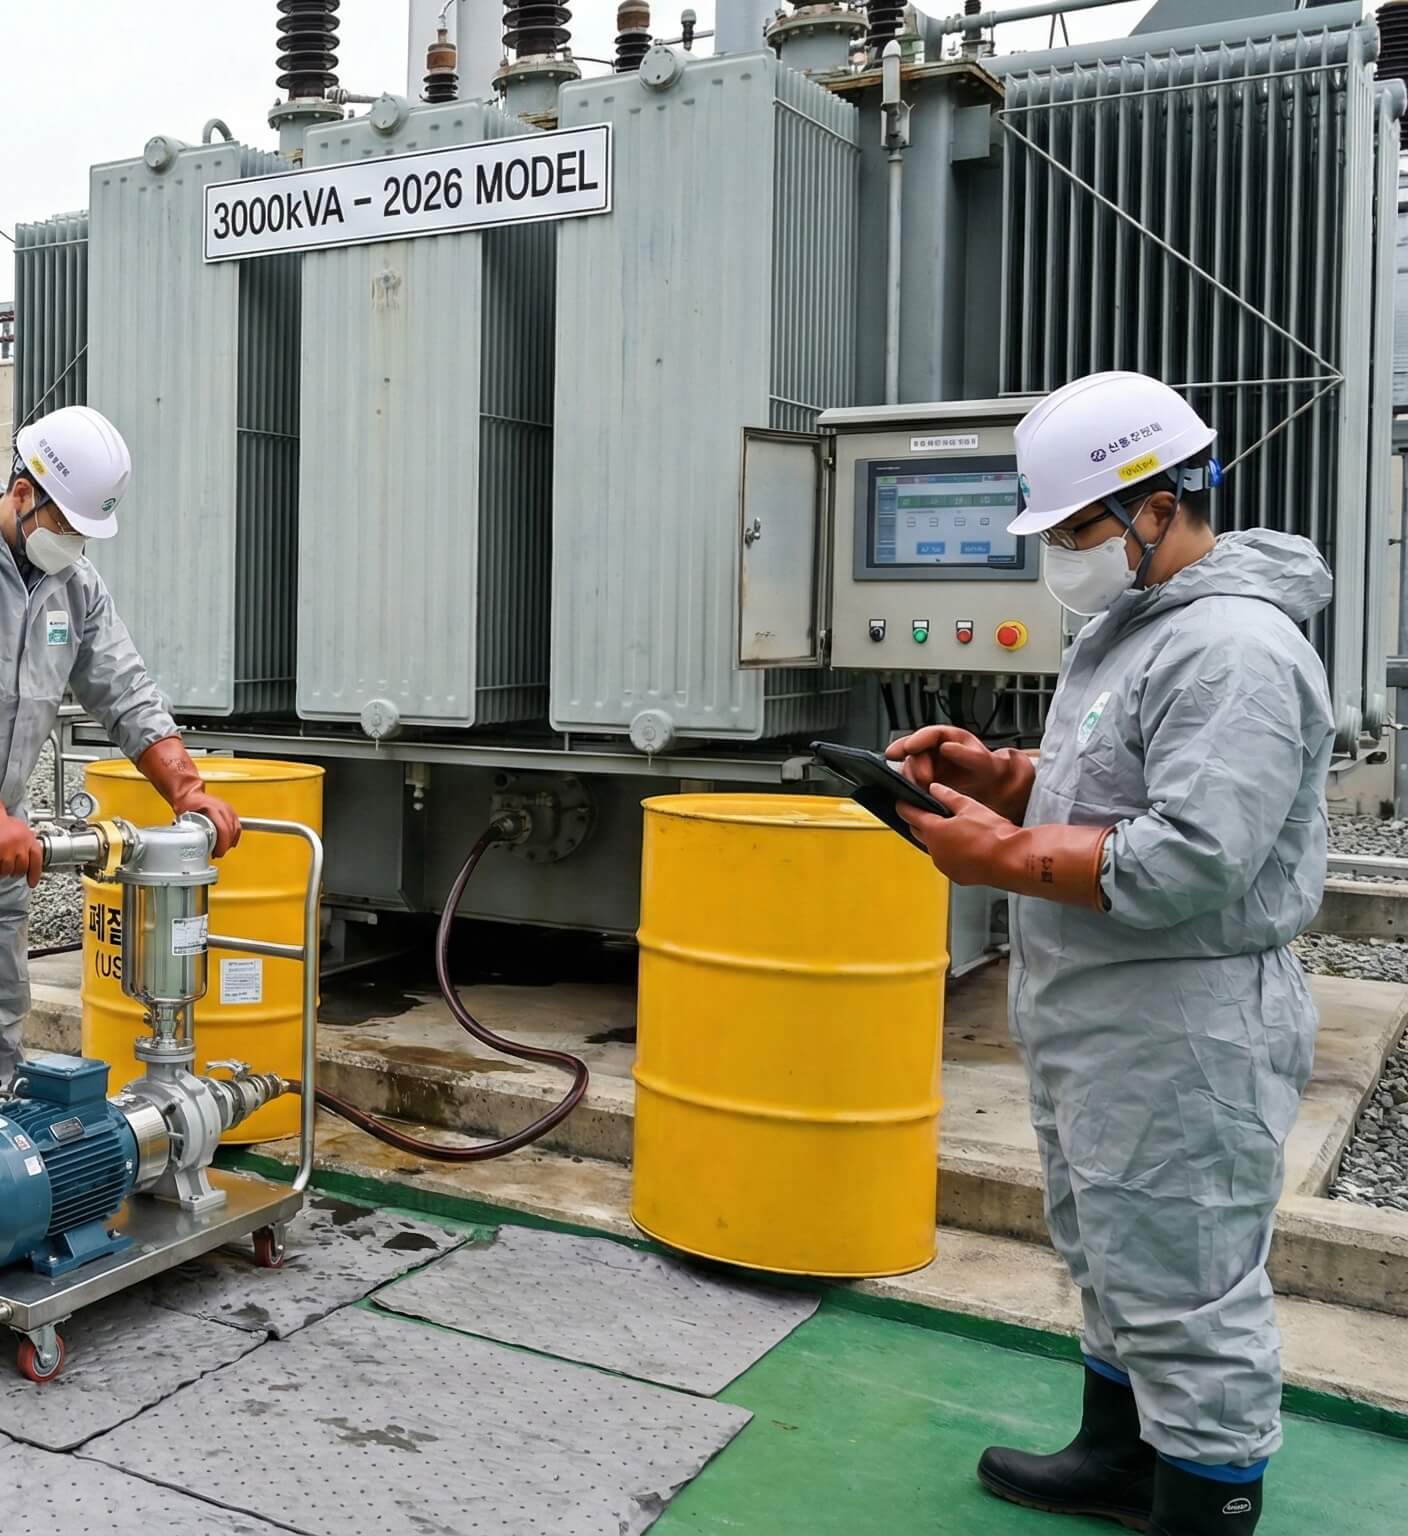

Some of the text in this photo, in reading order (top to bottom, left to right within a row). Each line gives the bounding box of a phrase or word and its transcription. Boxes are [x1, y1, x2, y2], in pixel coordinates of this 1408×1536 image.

[213, 185, 344, 240] 3000kVA
[384, 167, 462, 217] 2026
[476, 149, 599, 205] MODEL
